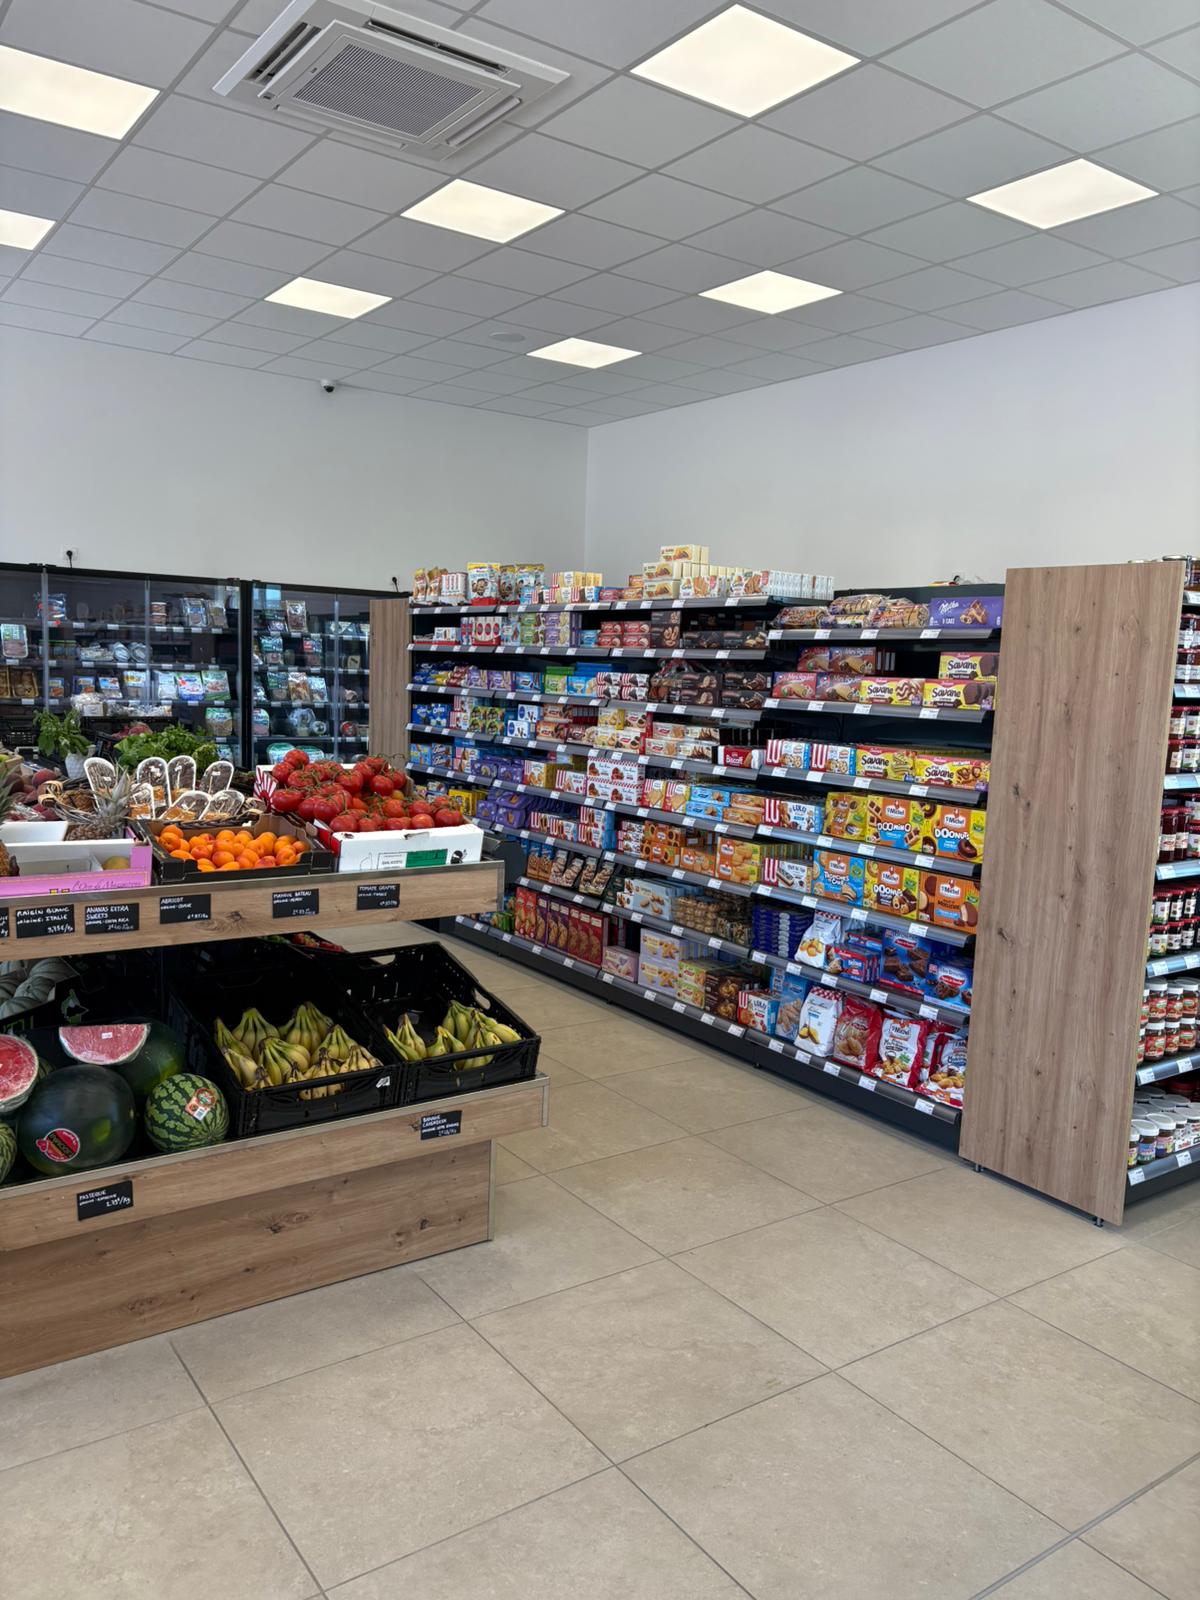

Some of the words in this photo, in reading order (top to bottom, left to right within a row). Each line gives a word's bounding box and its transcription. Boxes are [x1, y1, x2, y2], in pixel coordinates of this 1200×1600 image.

[938, 600, 960, 614] Milka
[948, 660, 978, 671] Savane
[867, 685, 893, 696] Savane
[932, 687, 961, 699] Savane
[767, 740, 782, 763] LU
[812, 744, 827, 768] LU
[861, 755, 889, 767] Savane
[925, 767, 954, 779] Savane
[765, 799, 780, 824] LU
[890, 808, 905, 817] Michel
[949, 816, 965, 826] Michel
[934, 828, 970, 841] DOONUTS
[765, 858, 779, 883] LU
[944, 885, 960, 896] Michel
